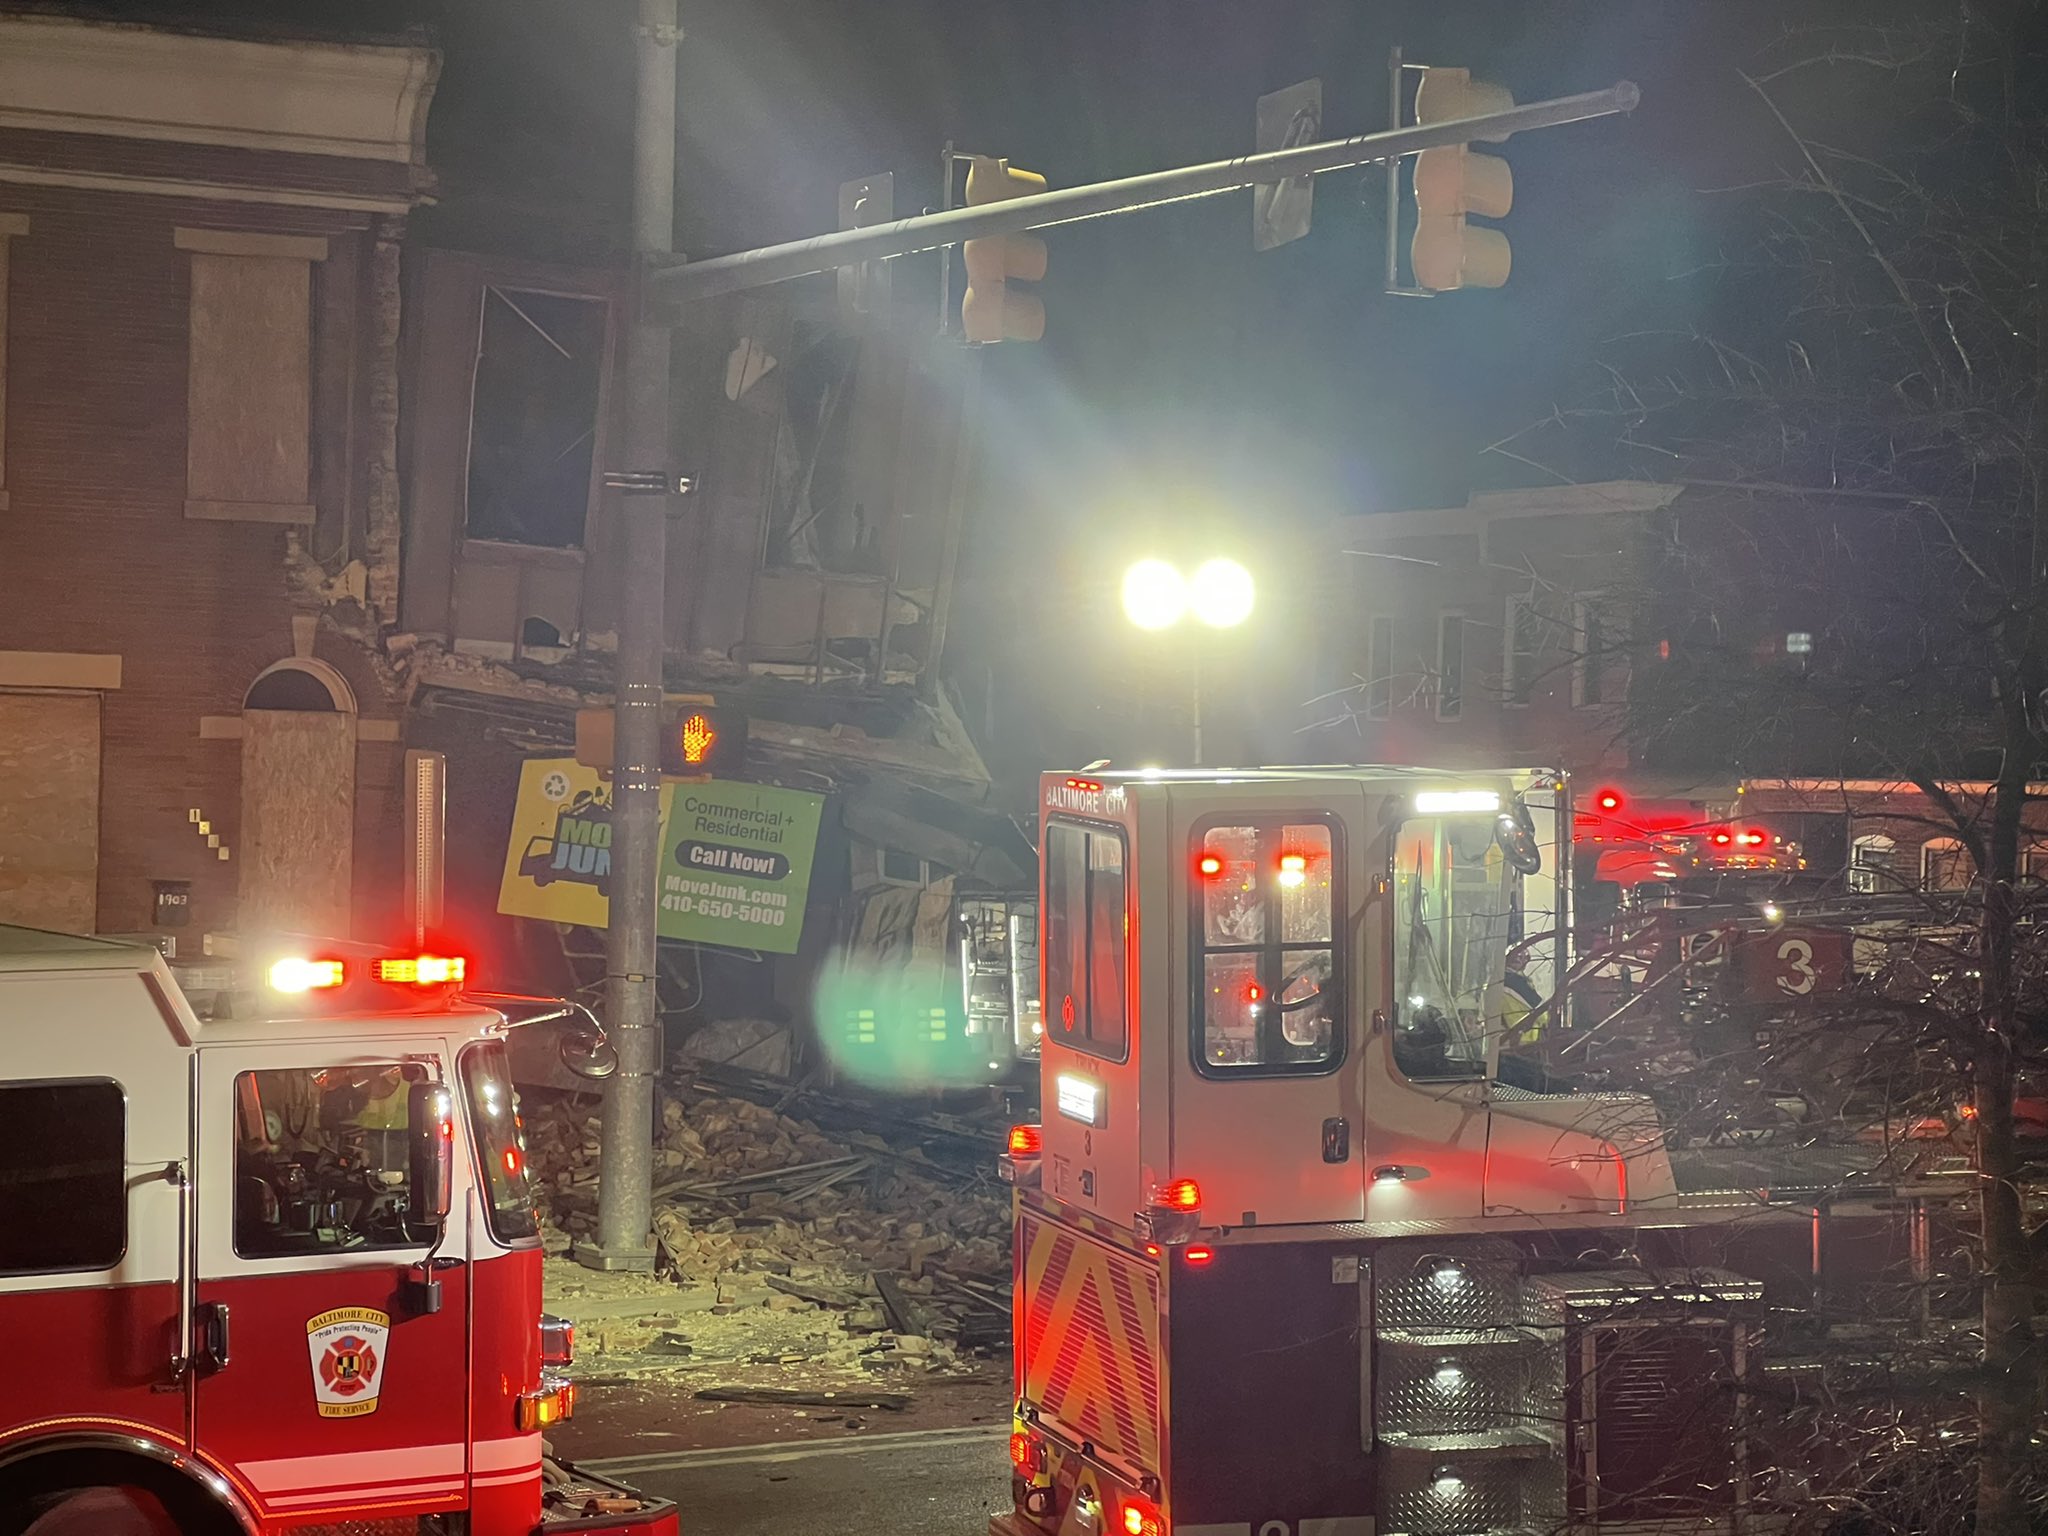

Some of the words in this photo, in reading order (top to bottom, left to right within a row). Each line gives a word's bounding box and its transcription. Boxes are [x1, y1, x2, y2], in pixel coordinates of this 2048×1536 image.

[685, 797, 783, 826] Commercial
[1046, 786, 1099, 813] BALTIMORE
[1105, 794, 1127, 816] CITY
[560, 818, 612, 848] MO
[694, 816, 784, 843] Residential
[550, 843, 611, 876] JUN
[690, 846, 728, 867] Call
[729, 852, 775, 874] Now!
[159, 893, 187, 905] 1903
[664, 875, 788, 907] MoveJunk.com
[661, 894, 785, 926] 410-650-5000
[1776, 940, 1815, 995] 3
[1085, 1129, 1092, 1156] 3
[312, 1310, 362, 1328] BALTIMORE
[365, 1311, 384, 1323] CITY
[343, 1402, 370, 1414] SERVICE
